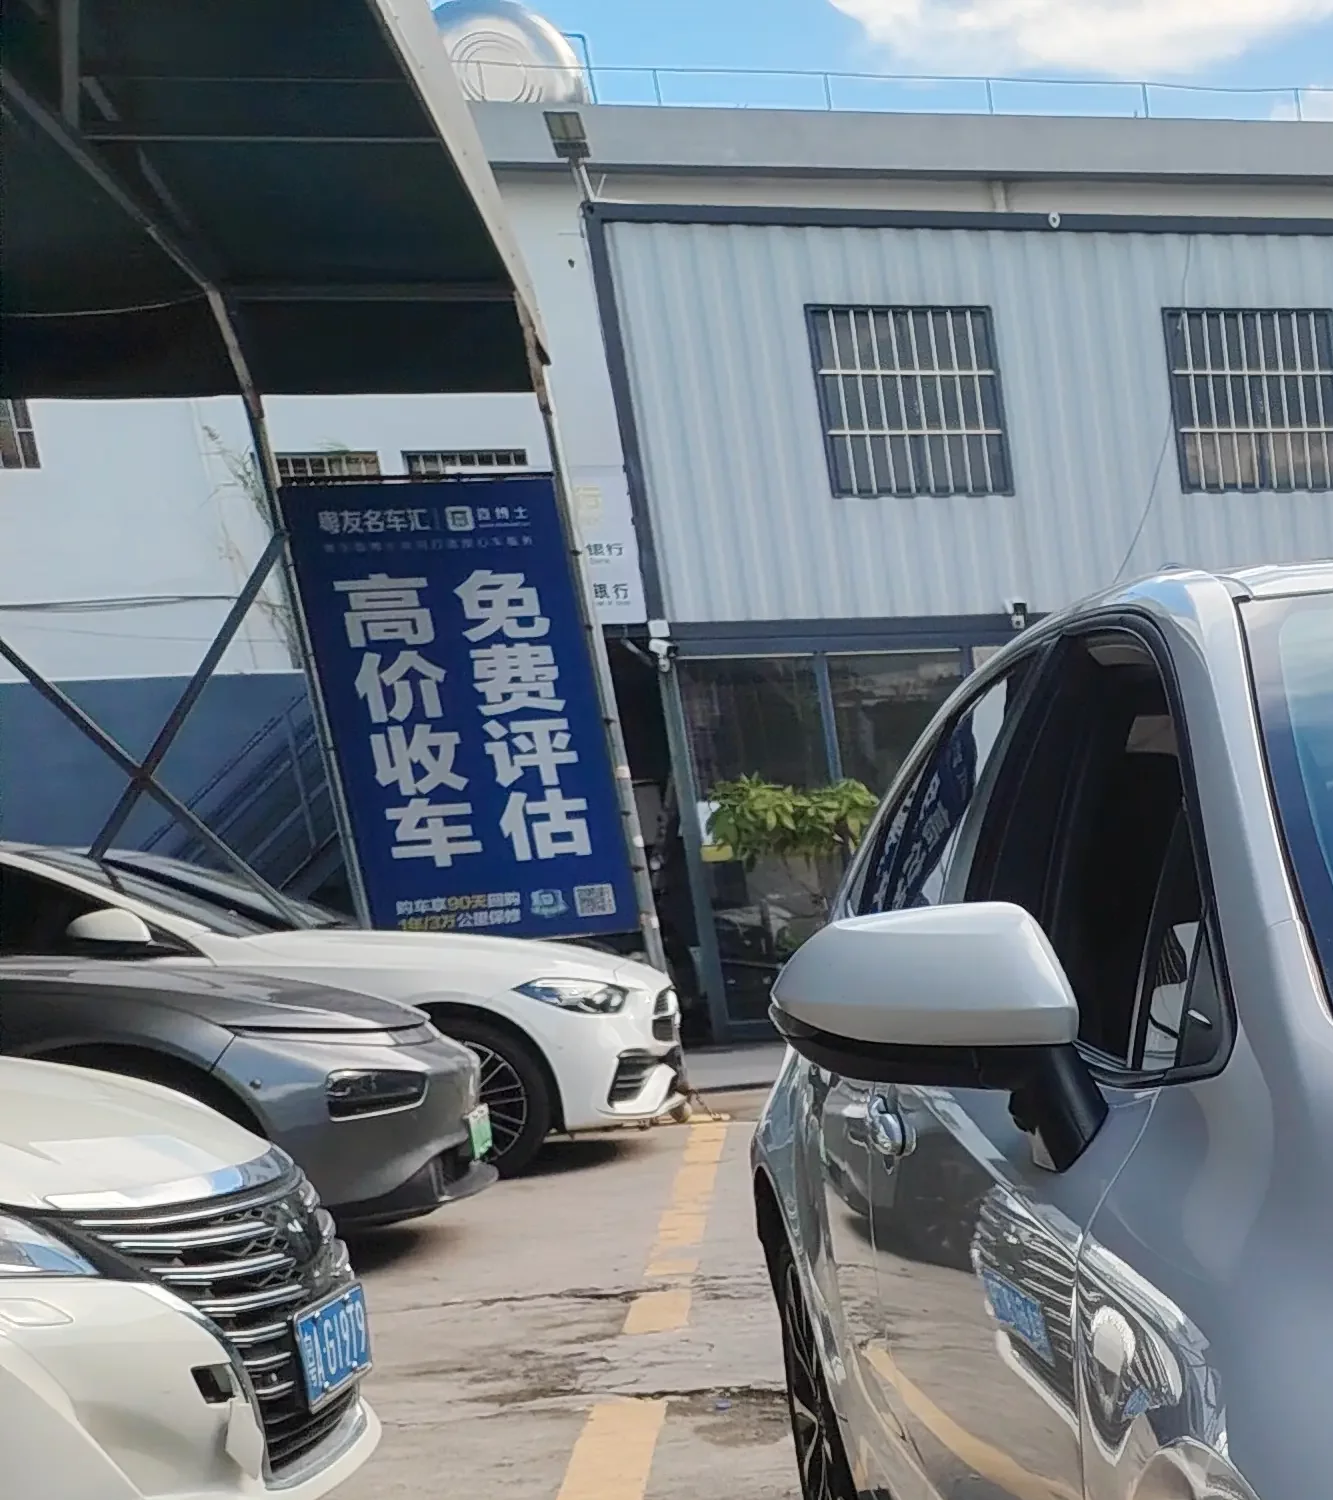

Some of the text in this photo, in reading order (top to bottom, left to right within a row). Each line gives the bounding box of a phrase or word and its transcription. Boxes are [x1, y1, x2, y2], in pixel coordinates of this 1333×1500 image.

[334, 573, 481, 867] 高价收车
[453, 570, 591, 862] 免费评估
